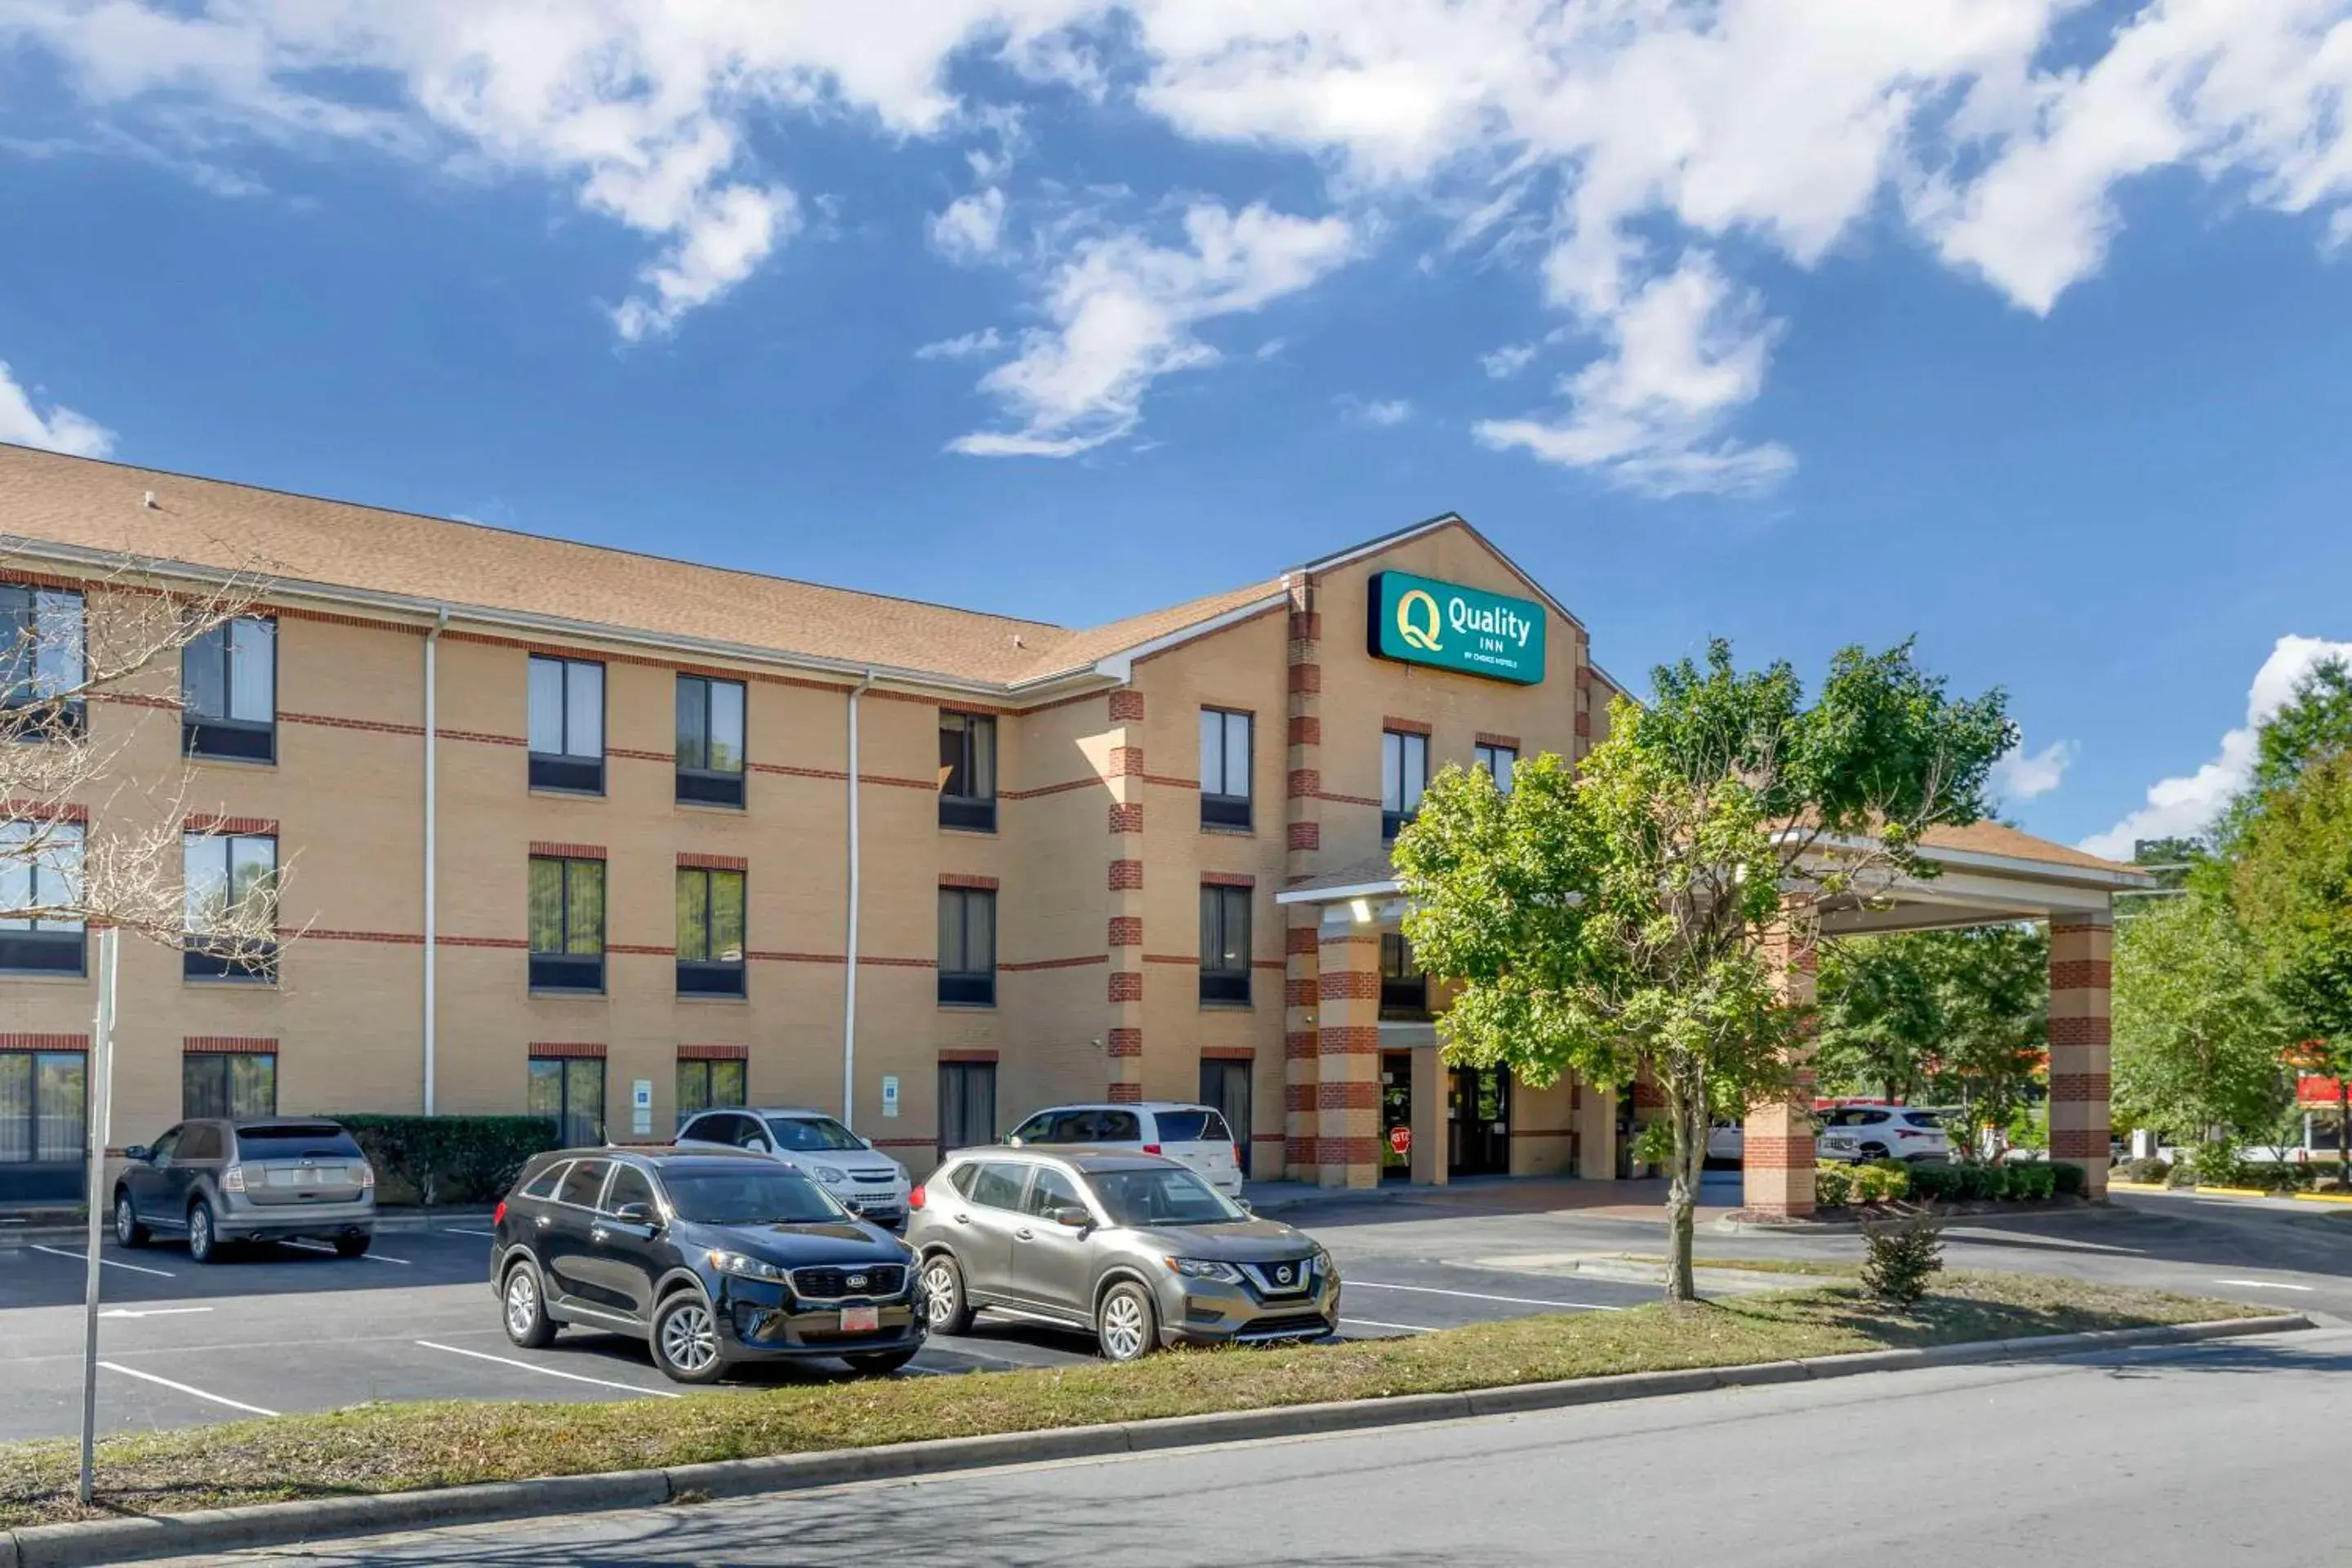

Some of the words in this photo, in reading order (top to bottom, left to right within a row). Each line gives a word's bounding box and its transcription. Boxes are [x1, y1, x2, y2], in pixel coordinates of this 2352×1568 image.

[1397, 589, 1443, 652] Q
[1449, 597, 1530, 648] Quality
[1480, 636, 1503, 653] INN
